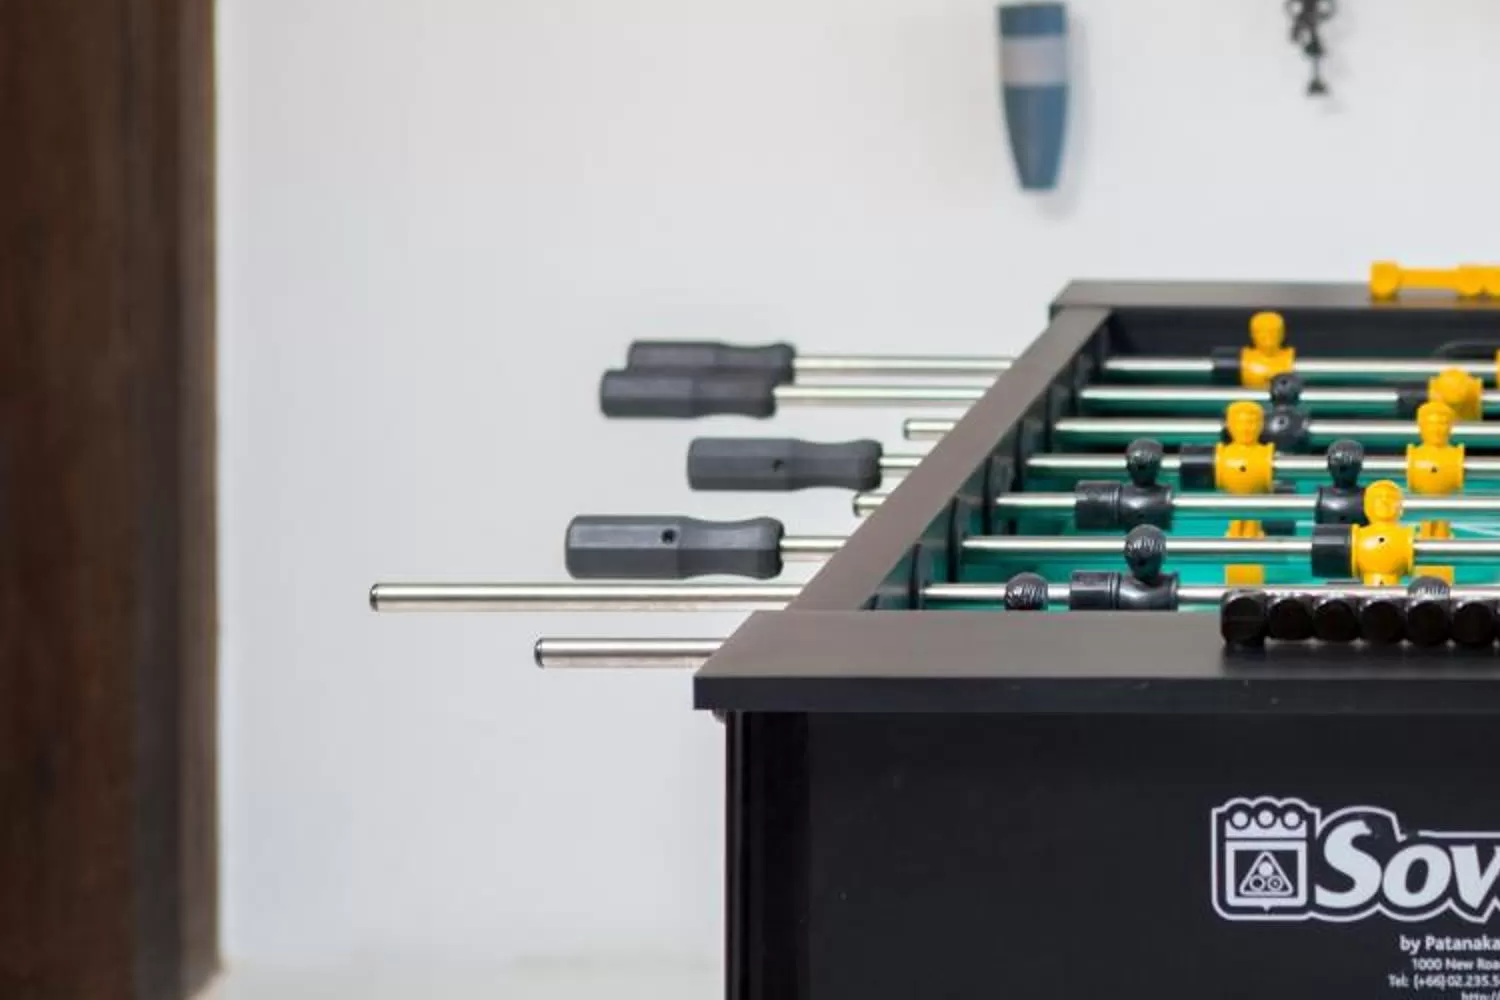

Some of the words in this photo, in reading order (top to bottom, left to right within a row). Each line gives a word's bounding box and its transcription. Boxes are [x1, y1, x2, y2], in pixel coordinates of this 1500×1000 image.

[1400, 933, 1421, 955] by
[1412, 957, 1442, 970] 1000
[1445, 957, 1474, 970] New
